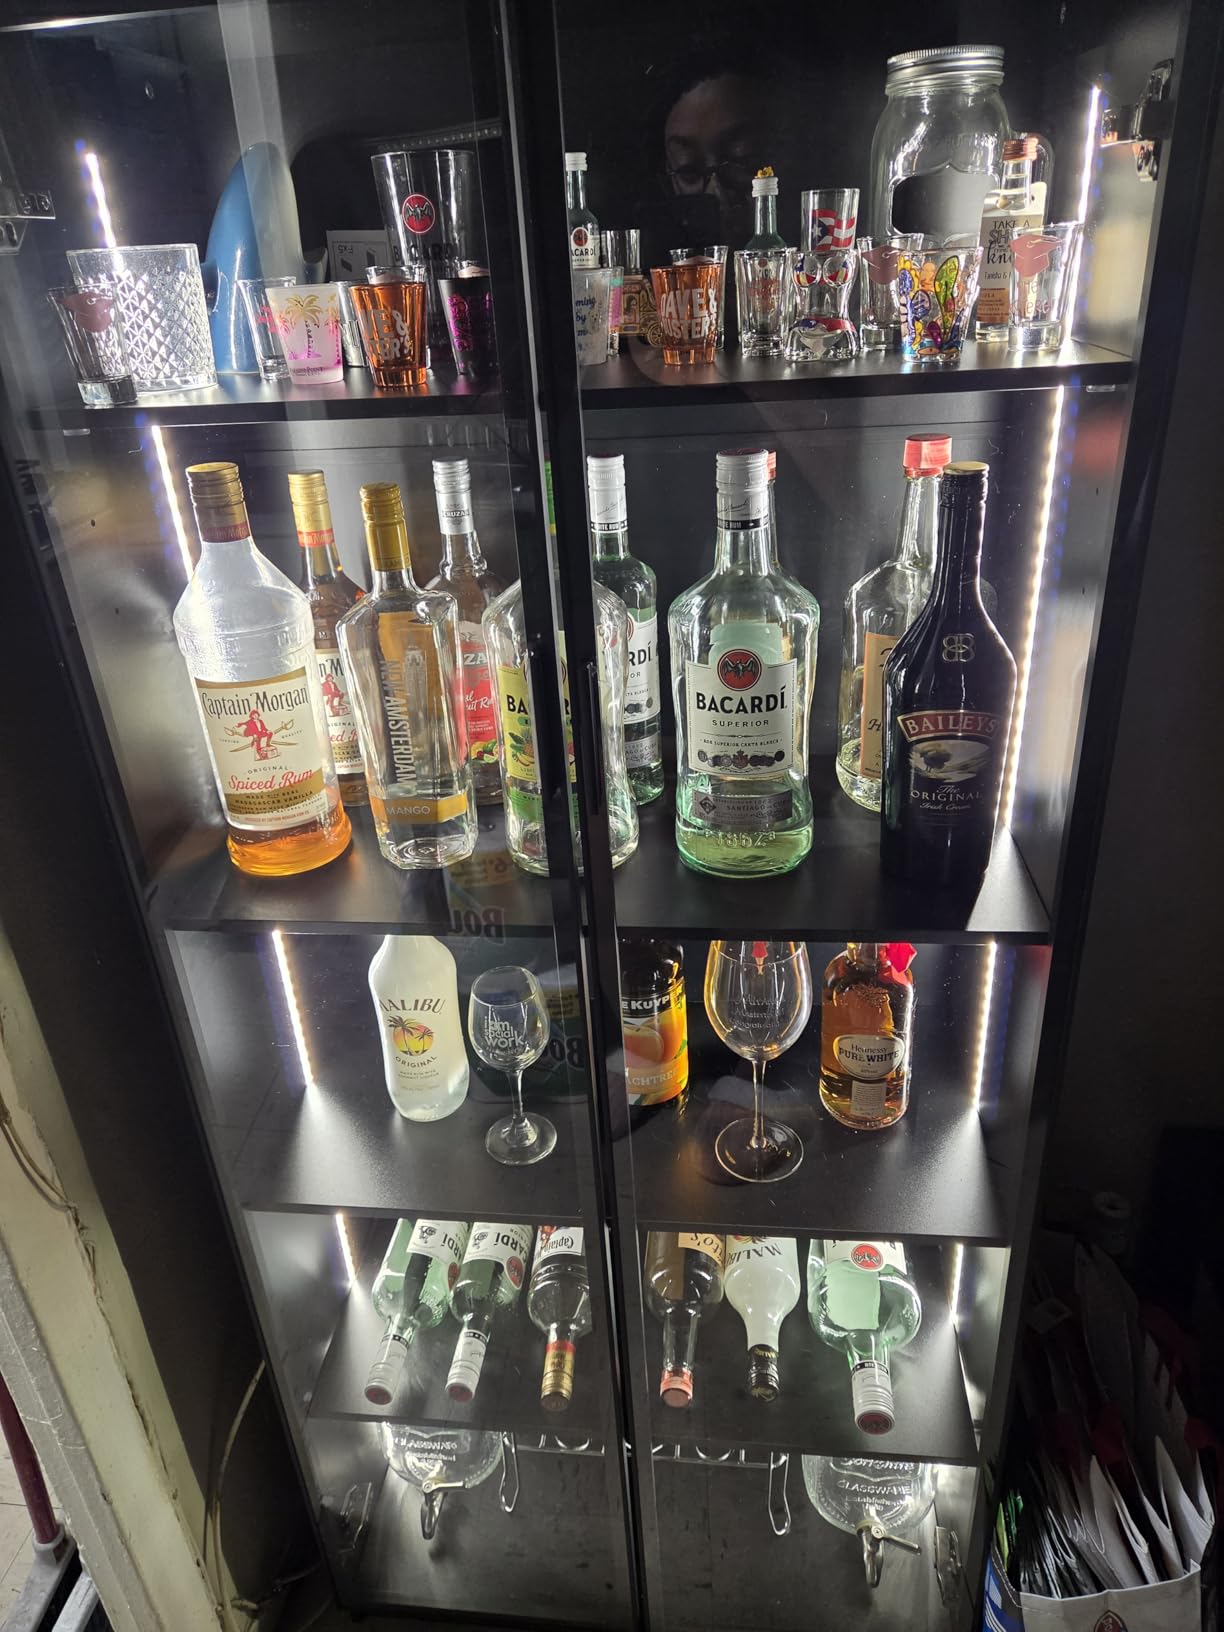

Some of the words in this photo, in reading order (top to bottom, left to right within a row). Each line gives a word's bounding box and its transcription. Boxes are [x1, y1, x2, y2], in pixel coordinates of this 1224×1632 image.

[392, 309, 409, 335] &
[202, 691, 250, 720] Captain
[248, 686, 309, 715] Morgan
[696, 684, 786, 714] BACARDÍ
[711, 719, 770, 729] SUPERIOR
[905, 714, 997, 735] BAILEYS
[247, 766, 288, 776] ORIGINAL
[228, 774, 276, 792] Spiced
[279, 768, 314, 789] Rum
[911, 790, 981, 802] ORIGINAL
[386, 806, 431, 816] MANGO
[838, 1047, 866, 1061] PURE
[866, 1050, 900, 1063] WHITE
[851, 1044, 887, 1054] Hennessy
[395, 1055, 438, 1069] ORIGINAL
